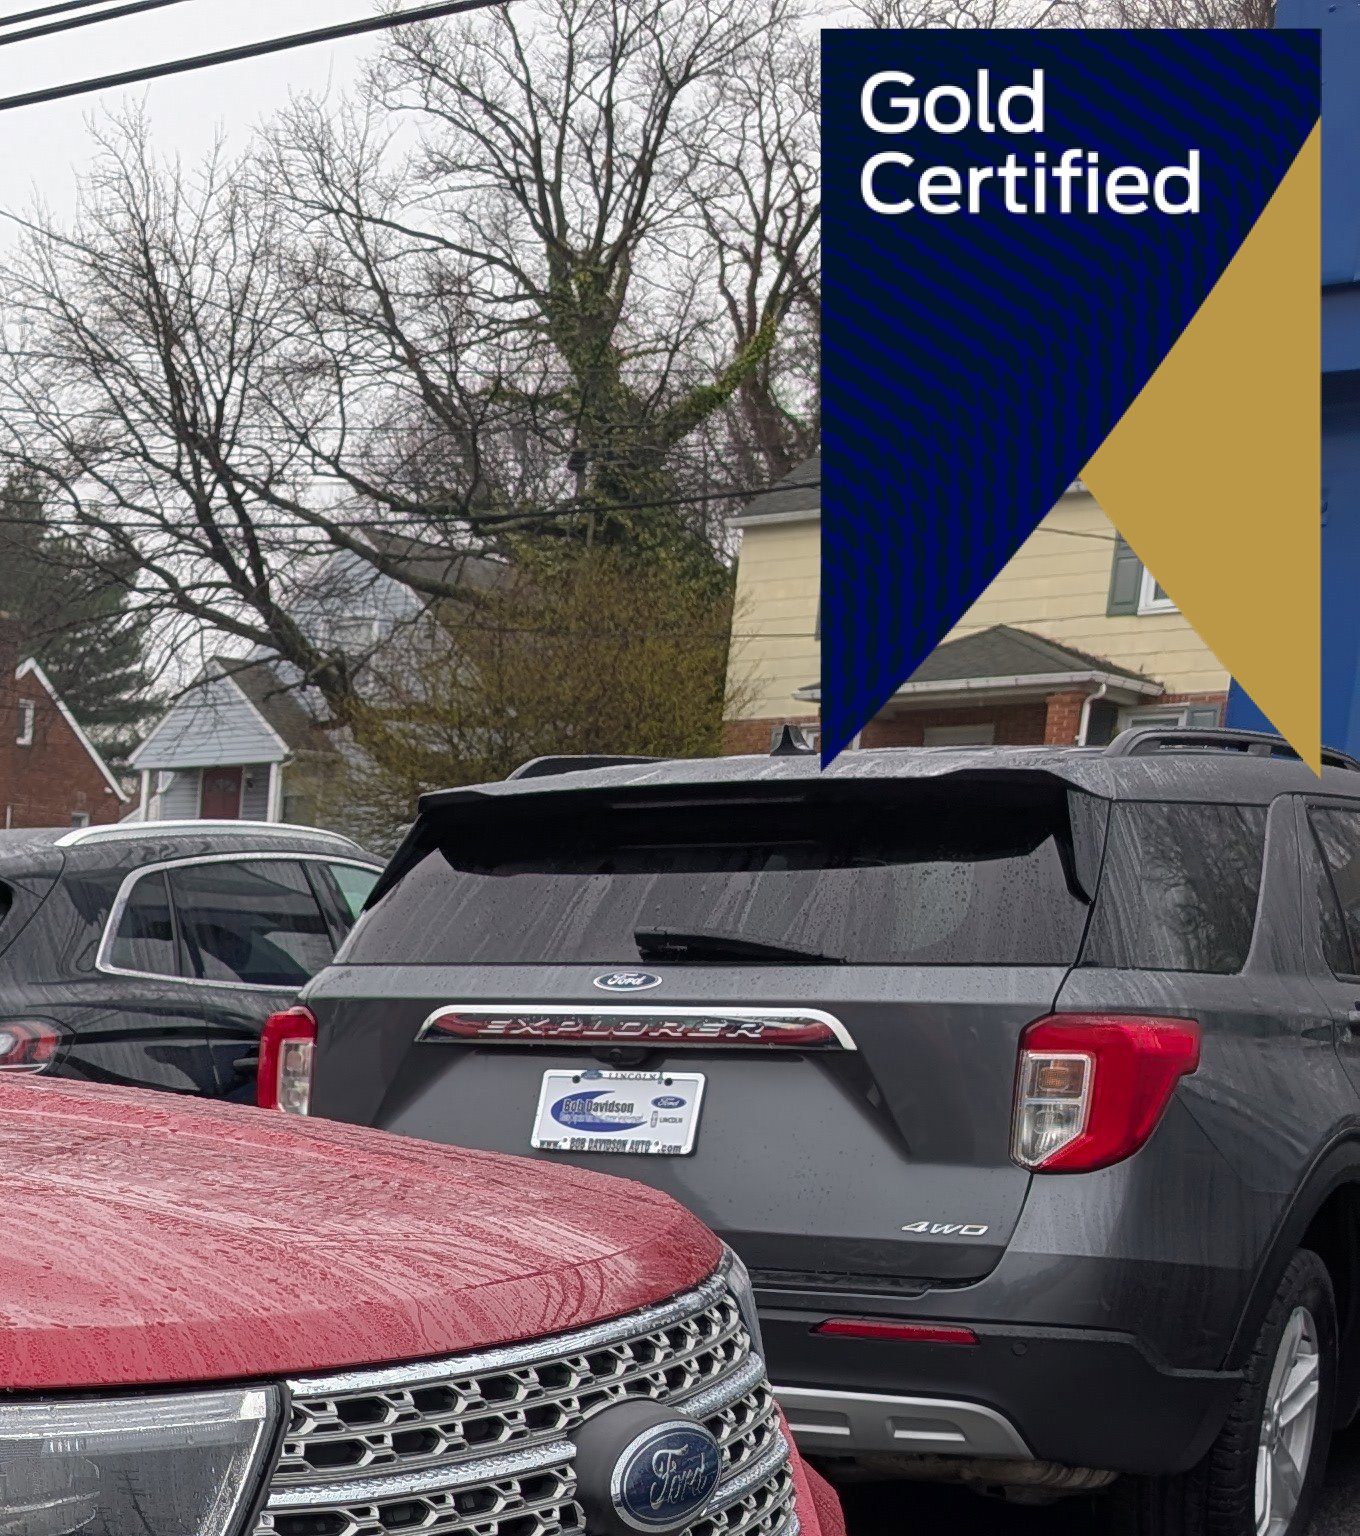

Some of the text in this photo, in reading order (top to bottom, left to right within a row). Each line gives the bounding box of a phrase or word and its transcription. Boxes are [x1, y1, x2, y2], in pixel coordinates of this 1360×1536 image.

[607, 972, 647, 986] Ford
[479, 1018, 766, 1038] EXPLORER
[563, 1098, 634, 1114] Bob Davidson
[901, 1221, 989, 1236] 4WD
[649, 1444, 708, 1510] Ford
